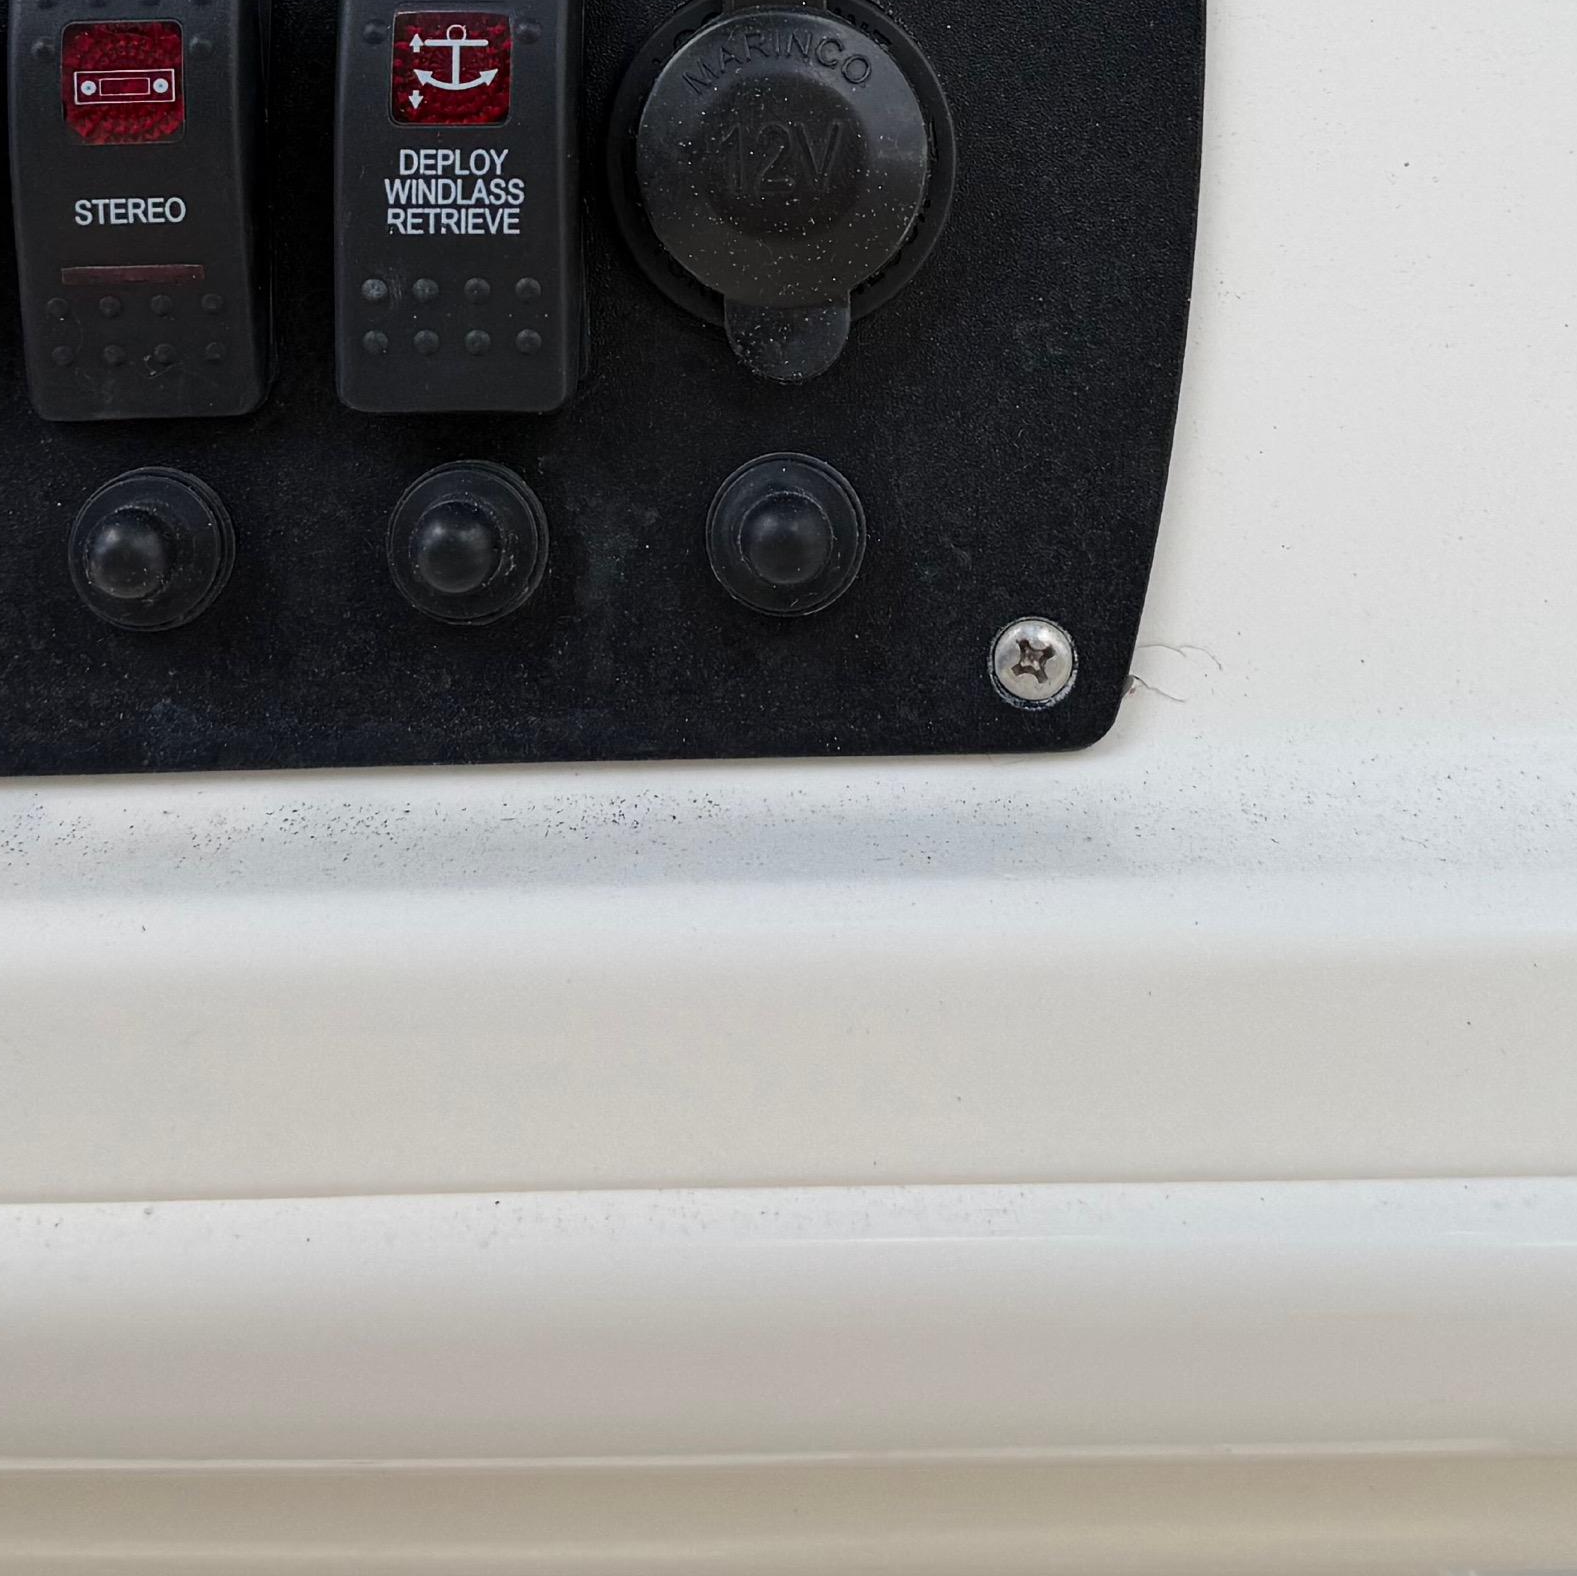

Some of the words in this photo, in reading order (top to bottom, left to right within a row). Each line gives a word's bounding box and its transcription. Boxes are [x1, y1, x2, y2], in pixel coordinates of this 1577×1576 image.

[682, 31, 874, 97] MARINCO
[399, 148, 509, 178] DEPLOY
[721, 118, 846, 196] 12V
[384, 179, 525, 208] WINDLASS
[74, 197, 186, 226] STEREO
[387, 208, 520, 235] RETRIEVE
